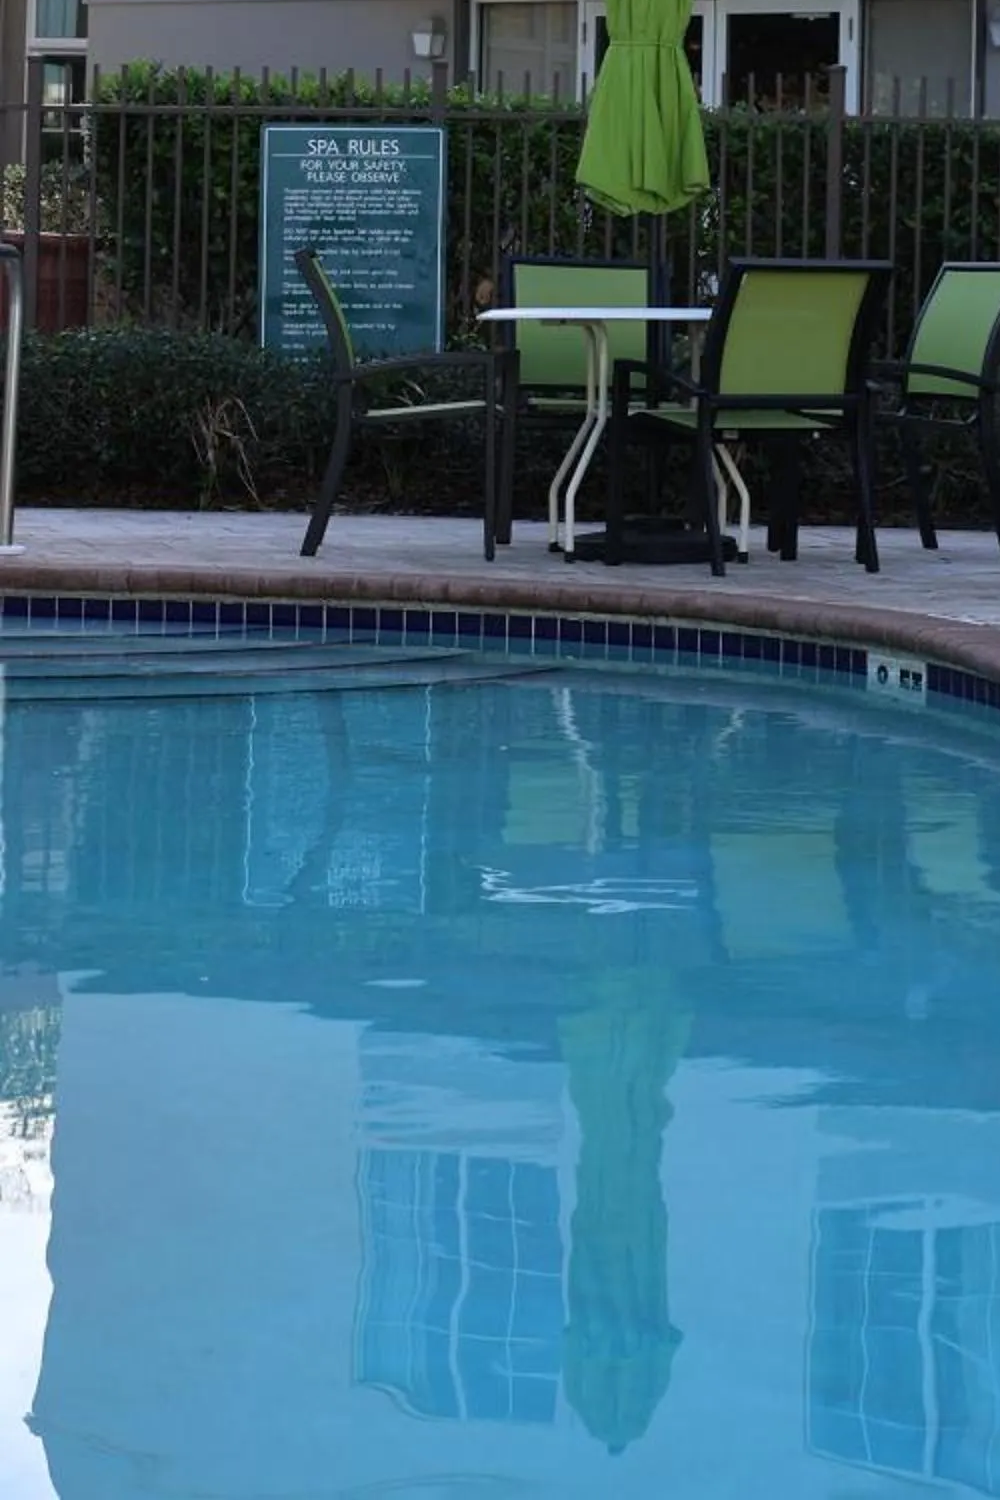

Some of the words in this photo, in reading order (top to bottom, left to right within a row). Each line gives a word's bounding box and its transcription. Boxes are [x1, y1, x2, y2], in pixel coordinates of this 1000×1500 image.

[307, 139, 339, 155] SPA
[348, 139, 400, 155] RULES
[301, 159, 323, 171] FOR
[328, 159, 359, 171] YOUR
[307, 171, 346, 183] PLEASE
[351, 172, 400, 184] OBSERVE
